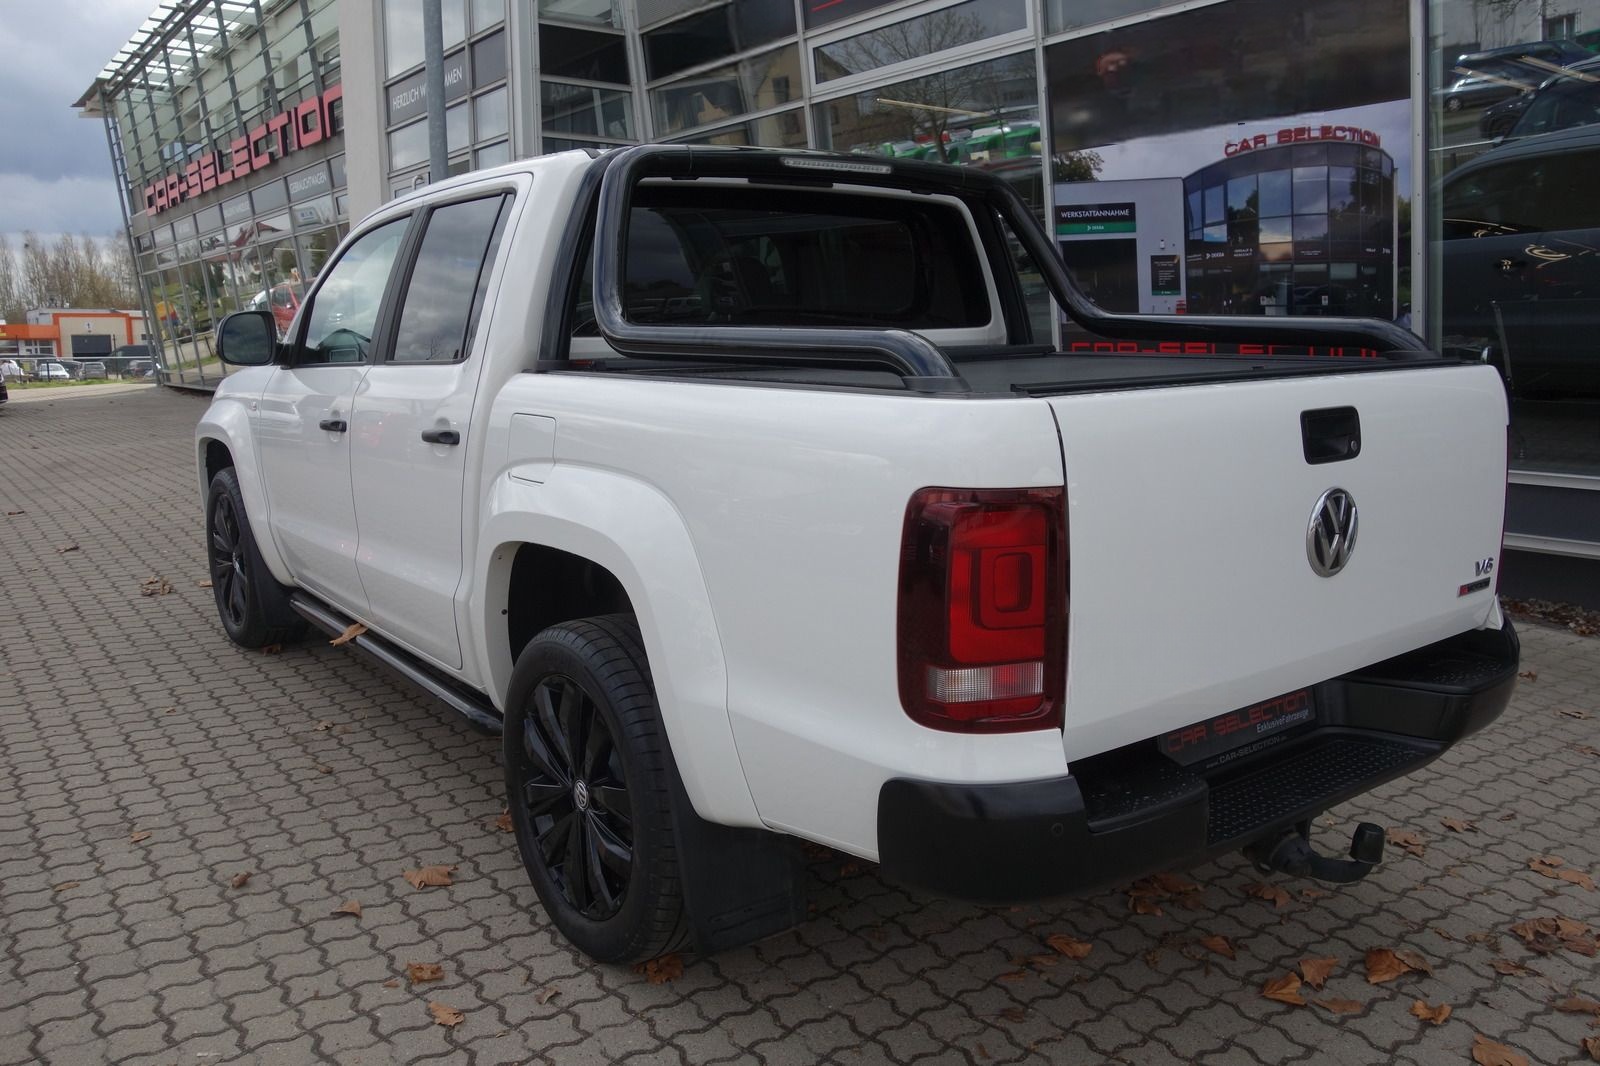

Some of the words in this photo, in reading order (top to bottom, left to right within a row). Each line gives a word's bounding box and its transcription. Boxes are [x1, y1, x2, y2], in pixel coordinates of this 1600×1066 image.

[392, 85, 420, 112] HERZLICH
[144, 83, 343, 217] CAR-SELECTION
[1224, 133, 1267, 158] CAR
[1277, 125, 1381, 148] SELECTION
[1060, 208, 1130, 219] WERKSTATTANNAHME
[1475, 556, 1494, 577] V6
